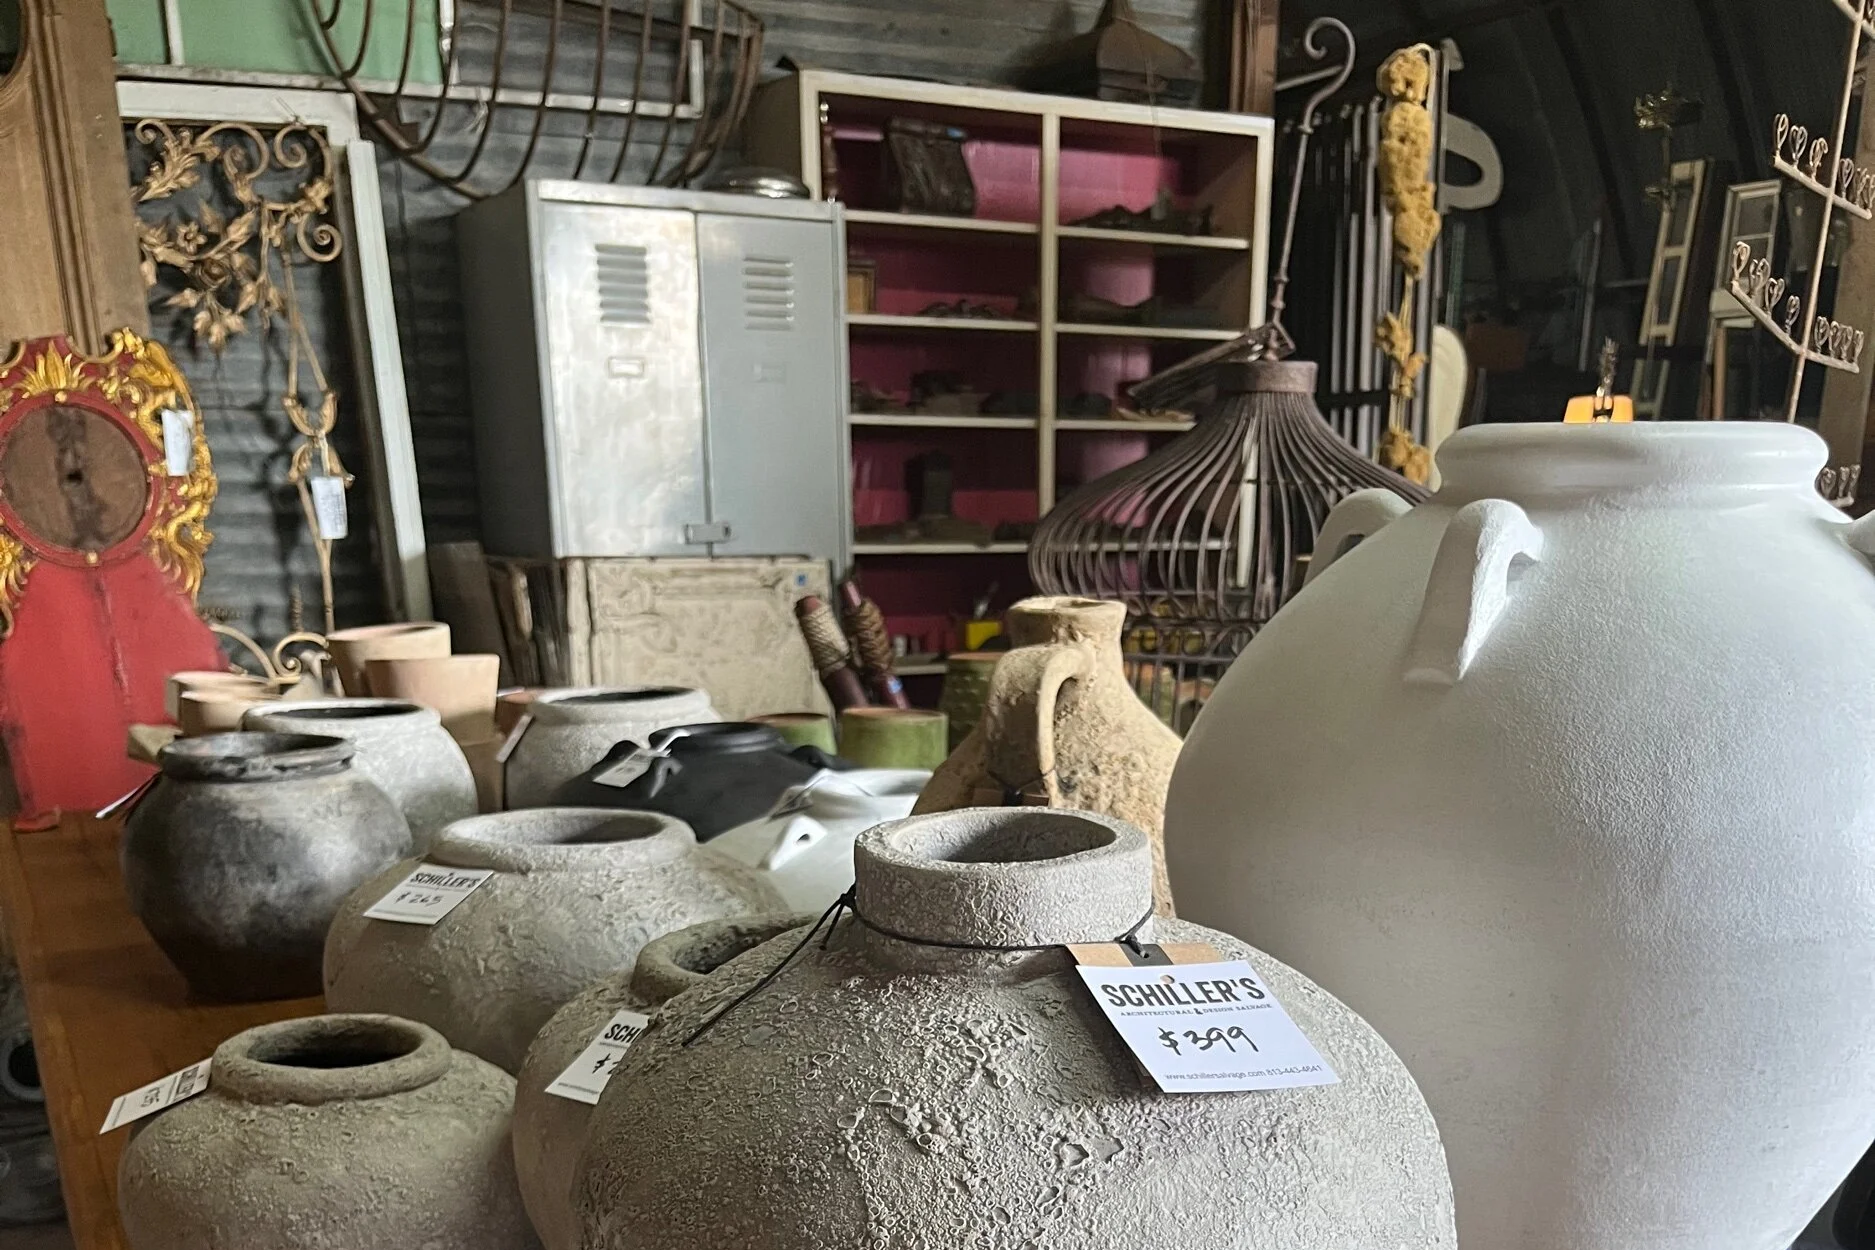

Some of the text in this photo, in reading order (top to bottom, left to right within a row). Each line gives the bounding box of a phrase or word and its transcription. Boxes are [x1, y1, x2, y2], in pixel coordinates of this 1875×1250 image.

[1101, 977, 1265, 1008] SCHILLER'S
[1120, 1003, 1273, 1017] ARCHITECTURAL & DESIGN SALVAGE
[1157, 1025, 1259, 1056] $399
